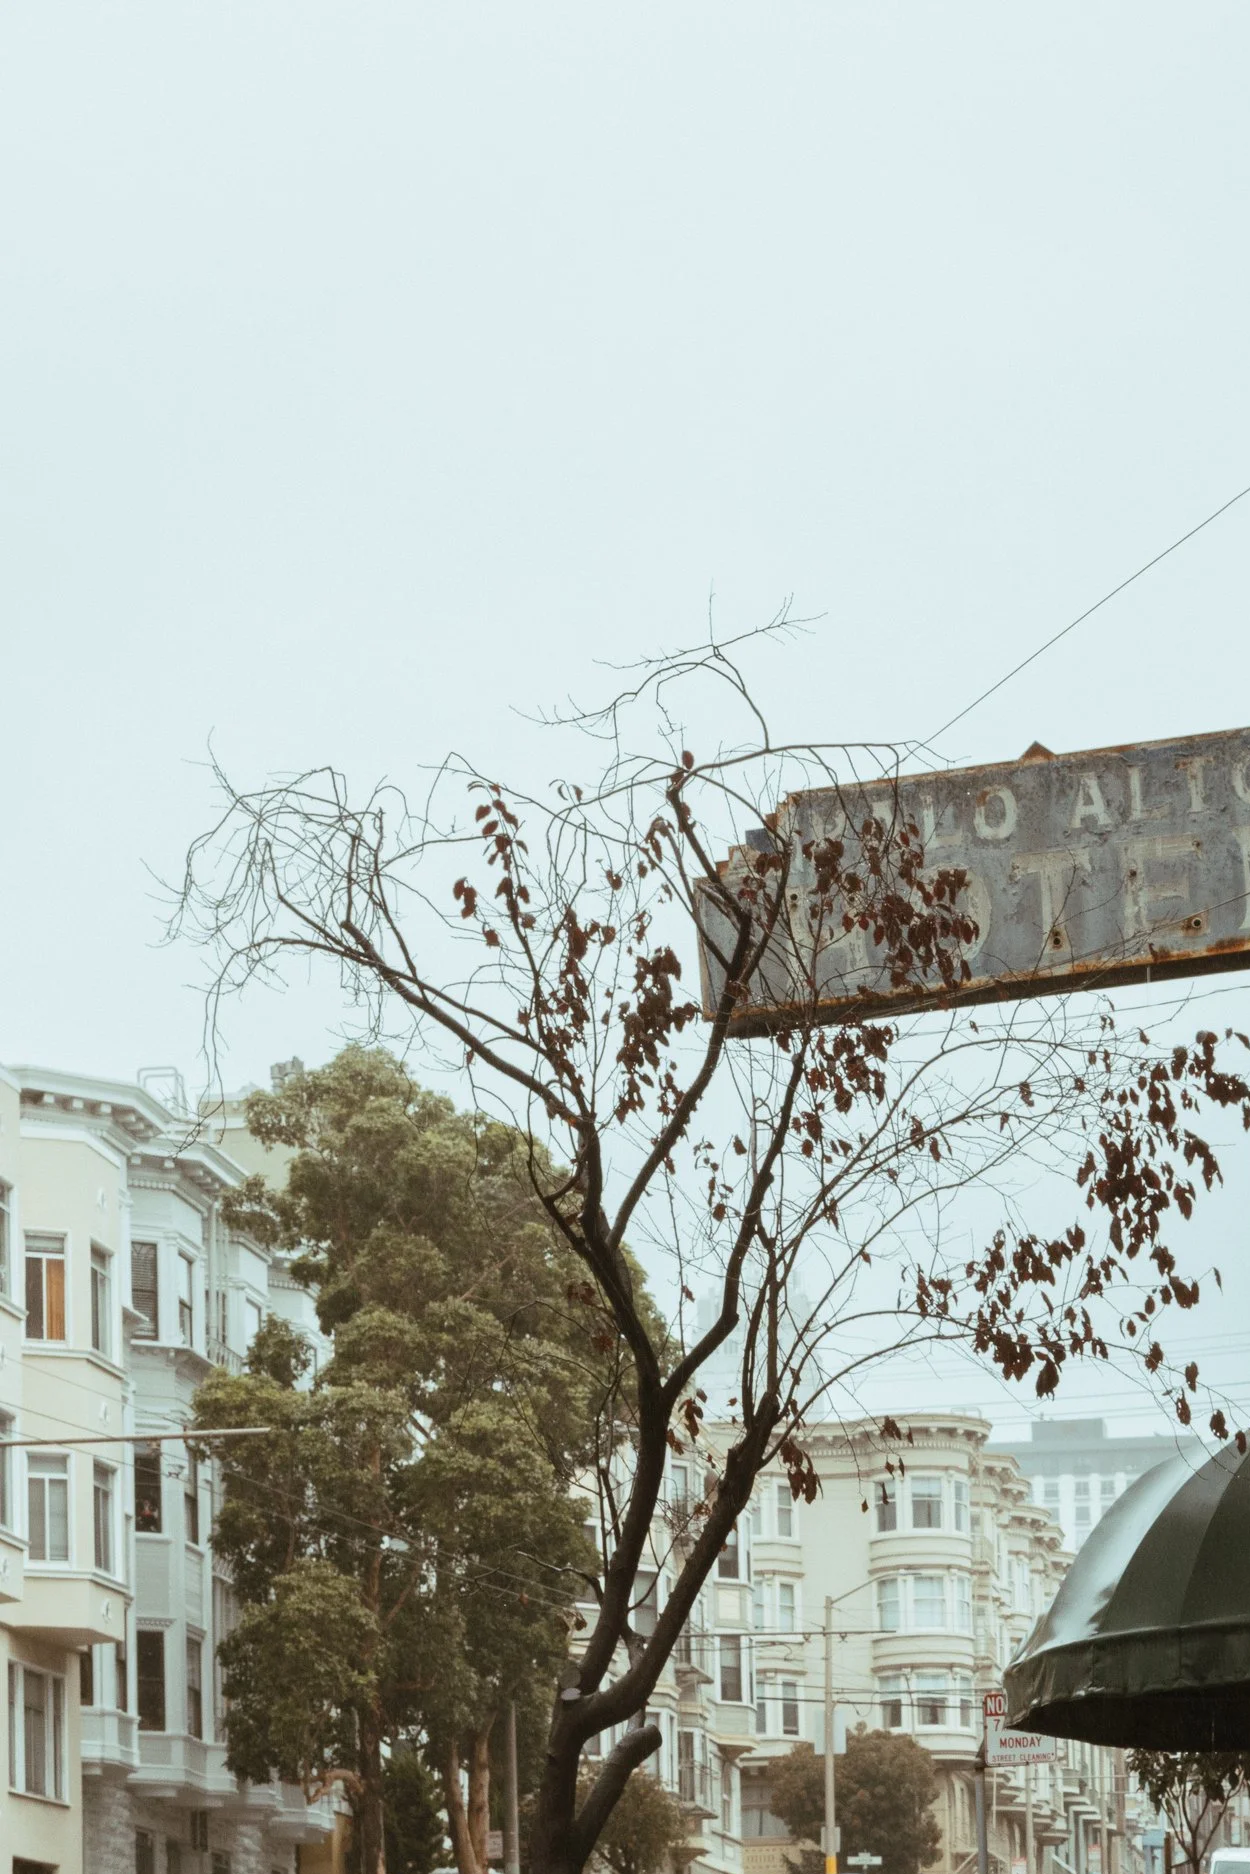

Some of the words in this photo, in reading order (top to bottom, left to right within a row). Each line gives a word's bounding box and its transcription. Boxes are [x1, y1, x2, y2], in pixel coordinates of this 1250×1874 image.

[986, 1695, 1004, 1715] NO
[999, 1736, 1042, 1749] MONDAY
[992, 1754, 1016, 1762] STREET
[1019, 1752, 1051, 1762] CLEANING
